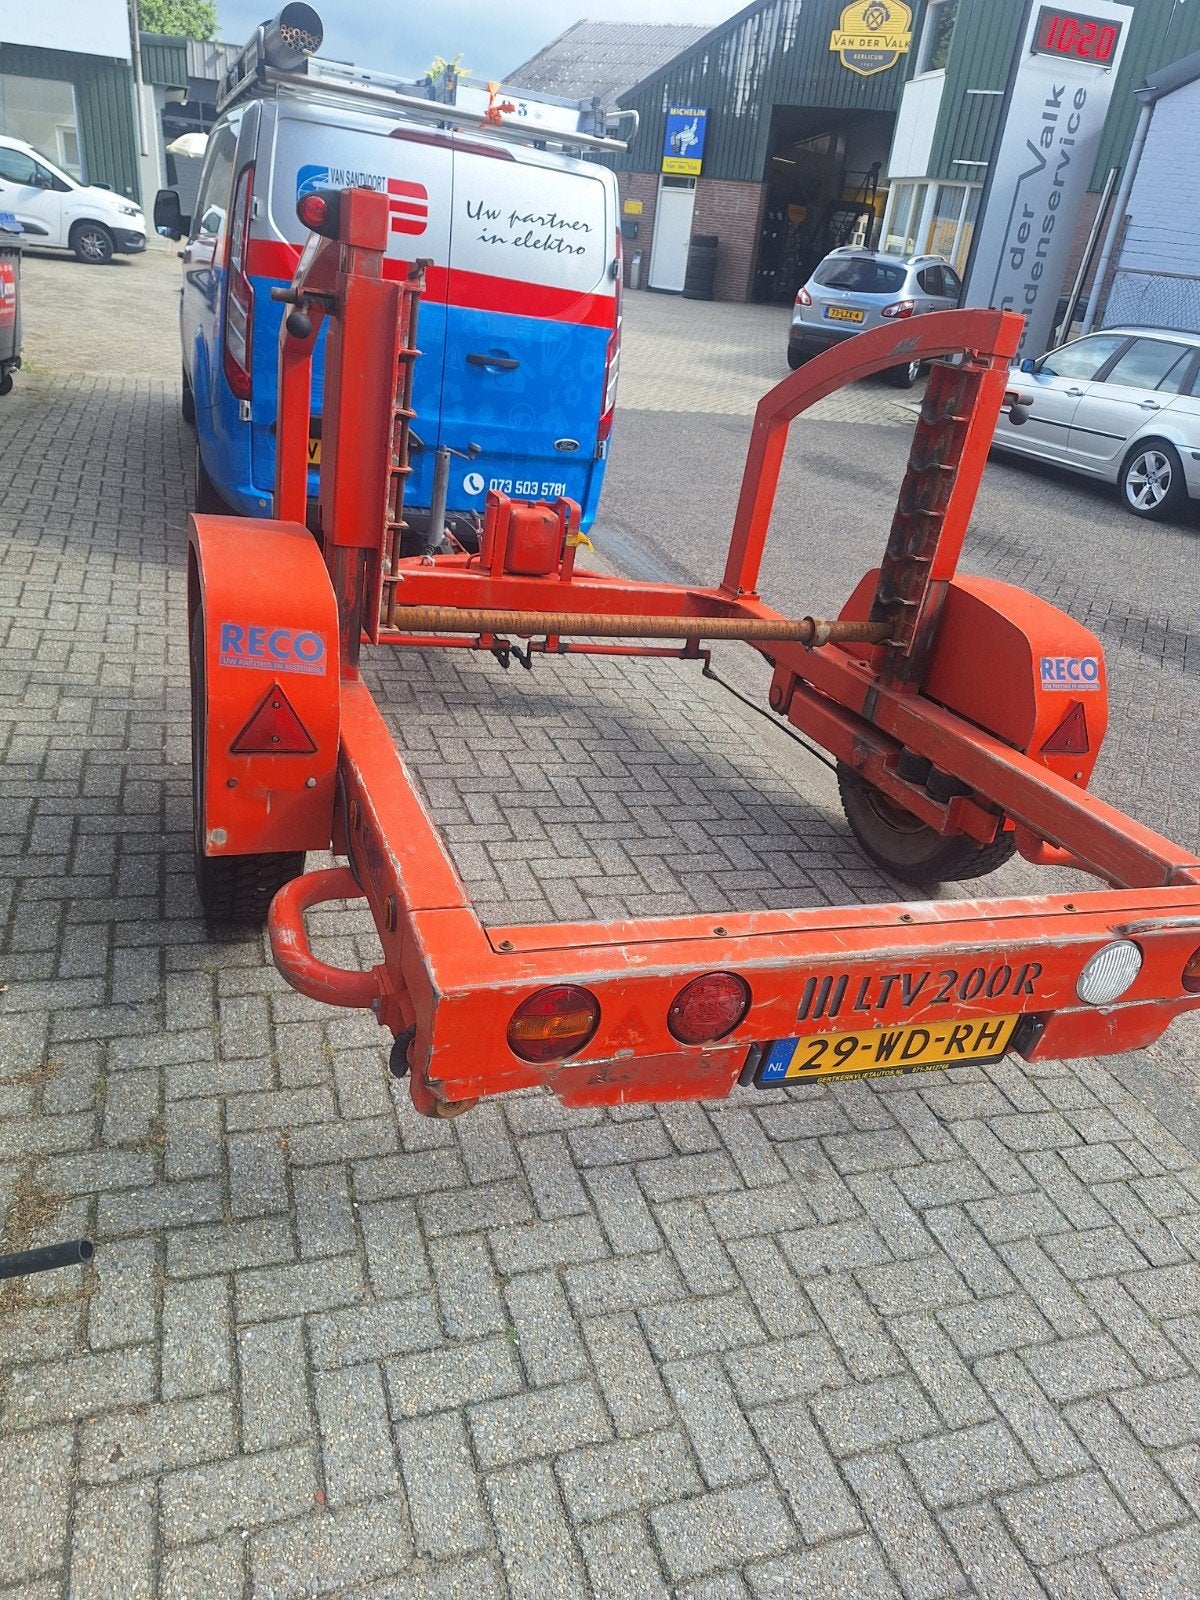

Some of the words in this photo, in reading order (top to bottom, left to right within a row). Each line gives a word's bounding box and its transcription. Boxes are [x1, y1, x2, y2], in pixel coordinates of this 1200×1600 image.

[833, 34, 855, 46] VAN
[859, 39, 880, 47] DER
[884, 35, 910, 48] VALK
[1046, 16, 1117, 60] 10:20
[670, 107, 706, 116] MICHELIN
[1018, 84, 1065, 181] Valk
[330, 167, 345, 186] VAN
[345, 170, 386, 192] SANTVOORT
[466, 199, 502, 221] Uw
[507, 209, 593, 233] partner
[477, 227, 507, 245] in
[511, 230, 586, 255] elektro
[1010, 202, 1035, 271] der
[489, 478, 513, 494] 073
[515, 481, 538, 495] 503
[541, 482, 567, 497] 5781
[221, 623, 325, 662] RECO
[1041, 658, 1098, 681] RECO
[853, 971, 931, 1012] LTV
[930, 962, 1043, 1006] 200R
[798, 1020, 1005, 1071] 29-WD-RH
[767, 1062, 785, 1072] NL
